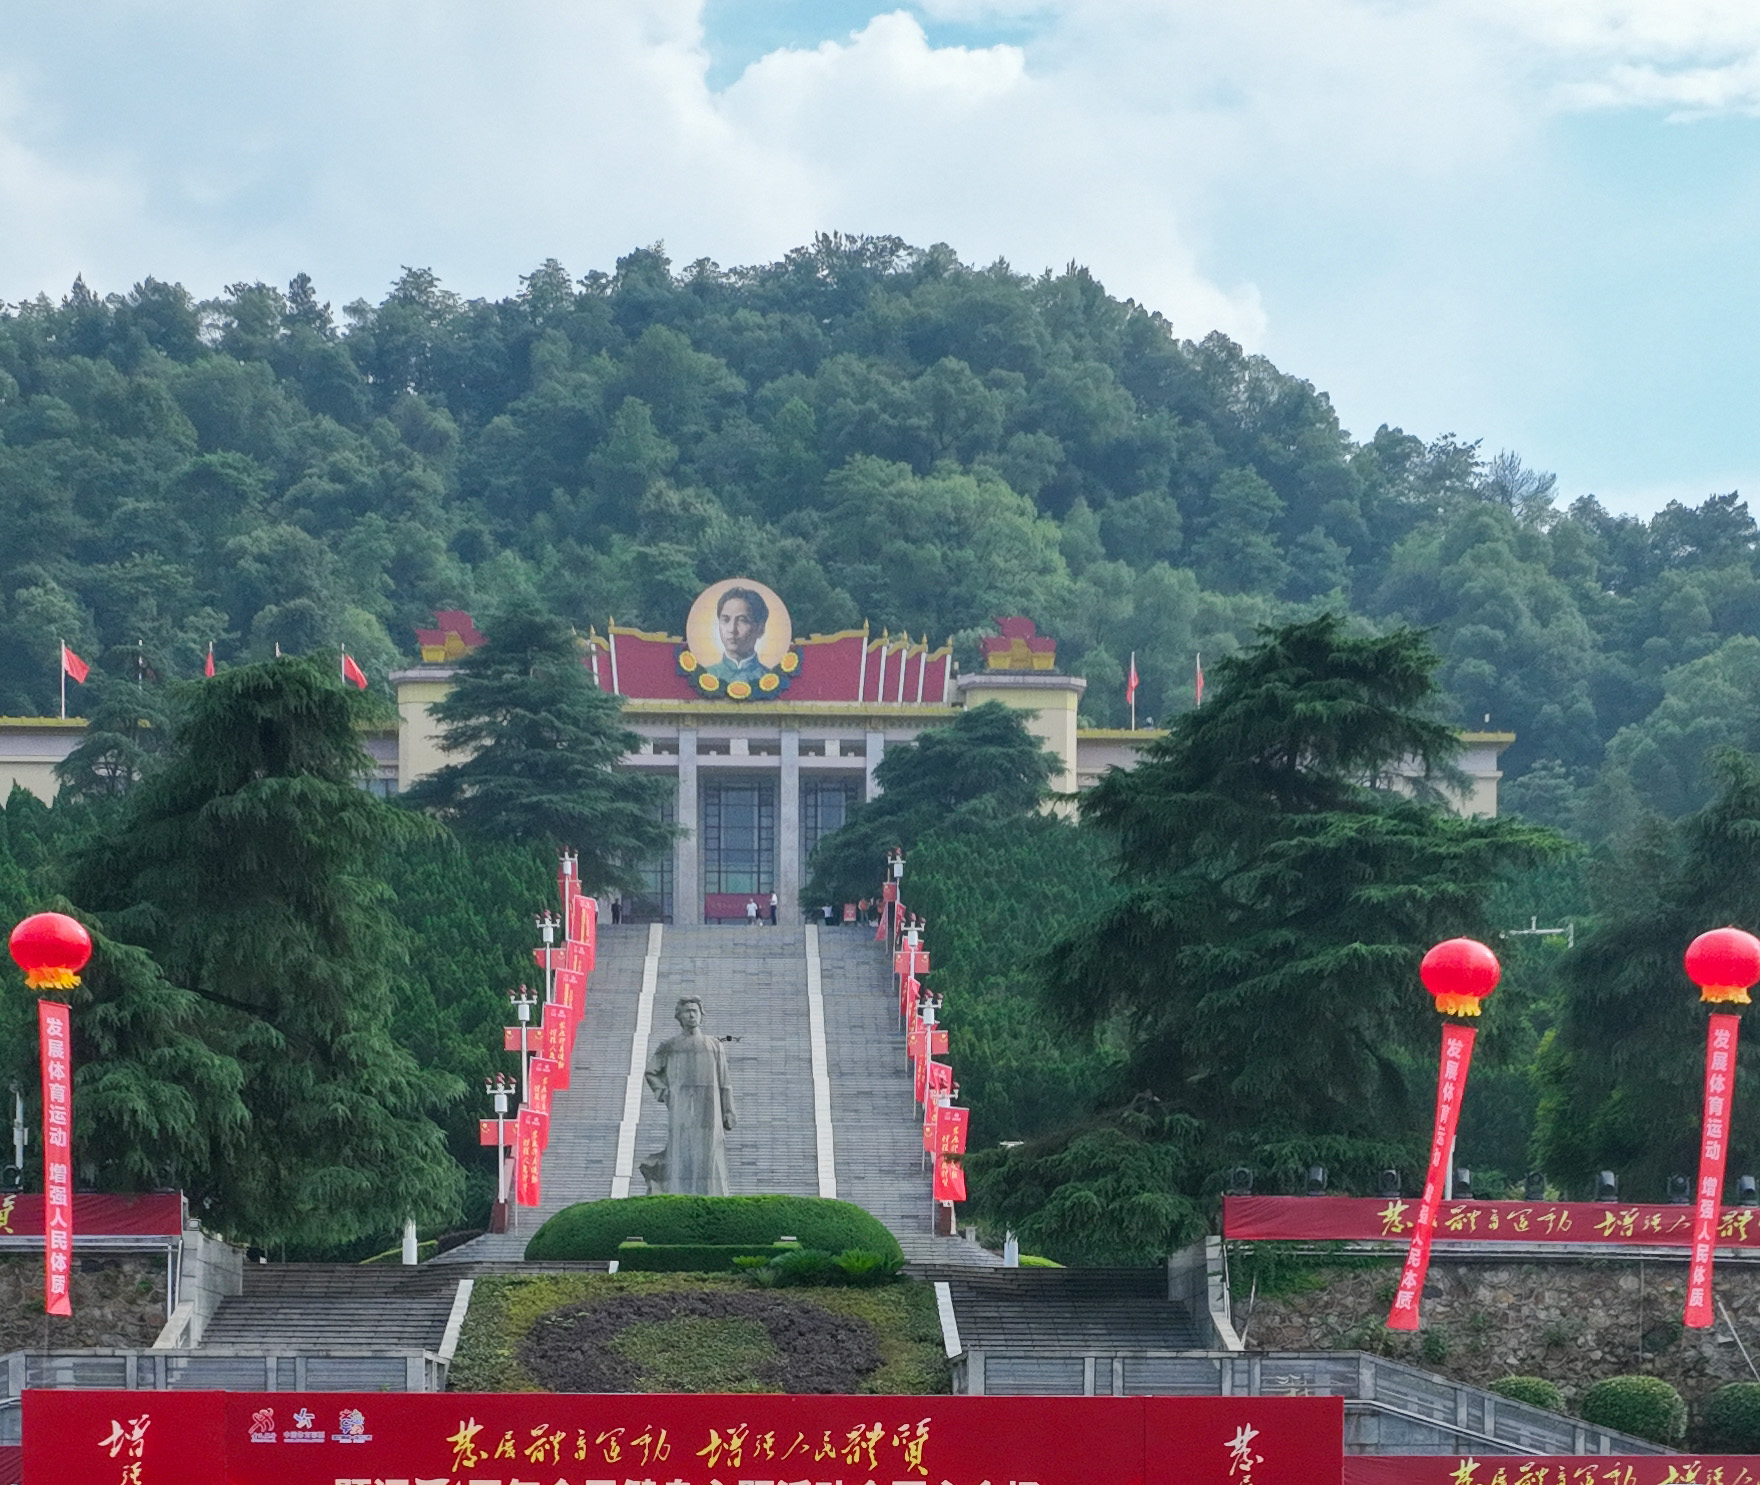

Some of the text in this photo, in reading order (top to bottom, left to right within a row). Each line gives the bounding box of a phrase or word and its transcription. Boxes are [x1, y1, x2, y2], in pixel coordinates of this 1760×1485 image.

[47, 1017, 67, 1295] 发展体育运动 增强人民体质
[1690, 1029, 1730, 1307] 发展体育运动 增强人民体质
